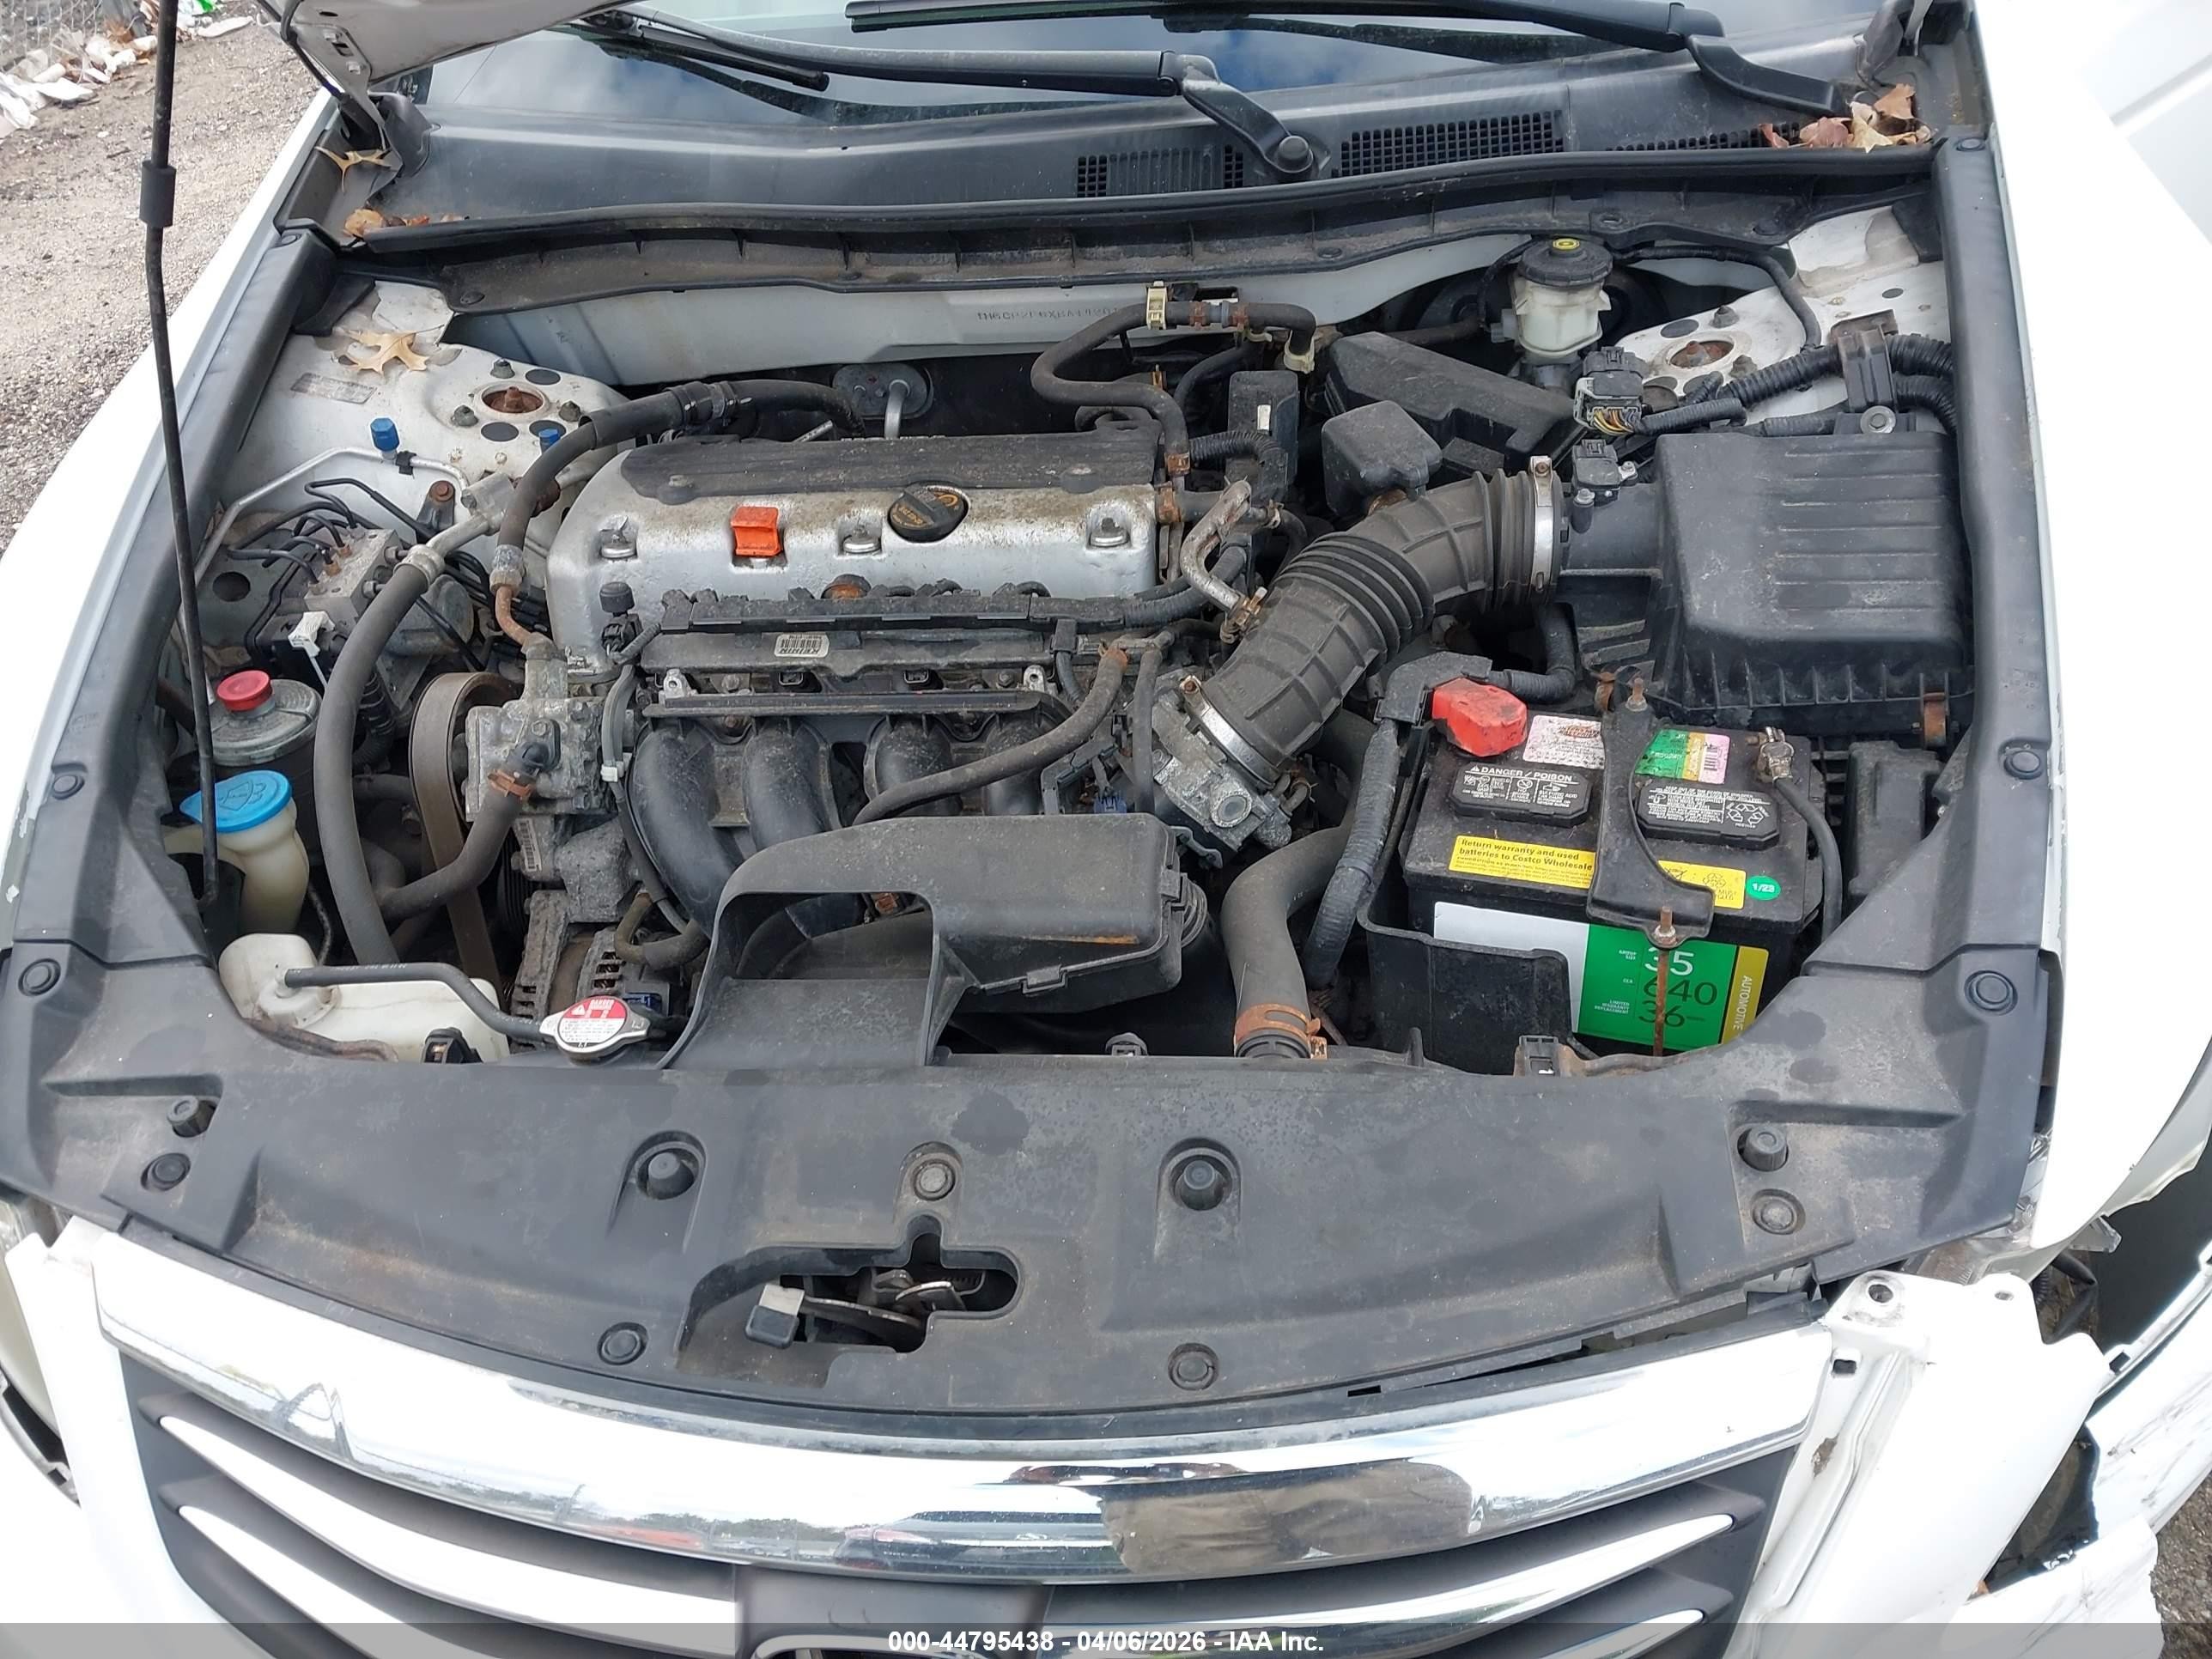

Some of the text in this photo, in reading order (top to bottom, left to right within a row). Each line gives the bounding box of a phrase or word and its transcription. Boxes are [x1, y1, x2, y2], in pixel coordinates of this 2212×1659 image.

[1481, 767, 1523, 777] DANGER
[1459, 848, 1498, 859] batteries
[1512, 854, 1541, 865] Costco
[1544, 859, 1593, 872] Wholesale
[1462, 839, 1579, 860] Return warranty and used
[1643, 975, 1718, 1006] 640
[1734, 975, 1753, 1030] AUTOMOTIVE
